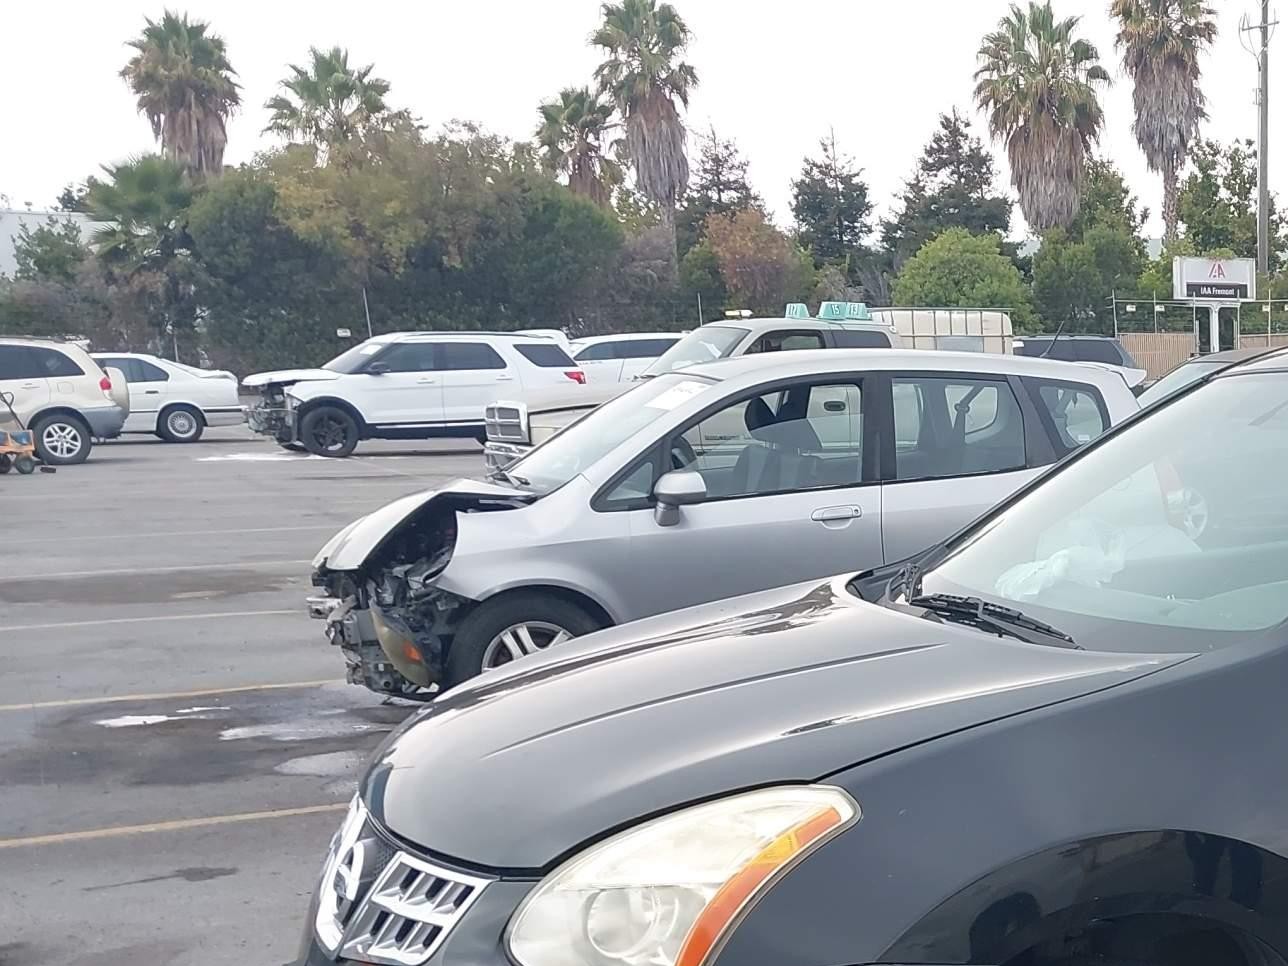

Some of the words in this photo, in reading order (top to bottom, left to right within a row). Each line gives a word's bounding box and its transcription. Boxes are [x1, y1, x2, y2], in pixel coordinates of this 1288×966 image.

[1200, 286, 1212, 295] IAA
[1212, 286, 1235, 296] Fremont
[831, 304, 840, 315] 15
